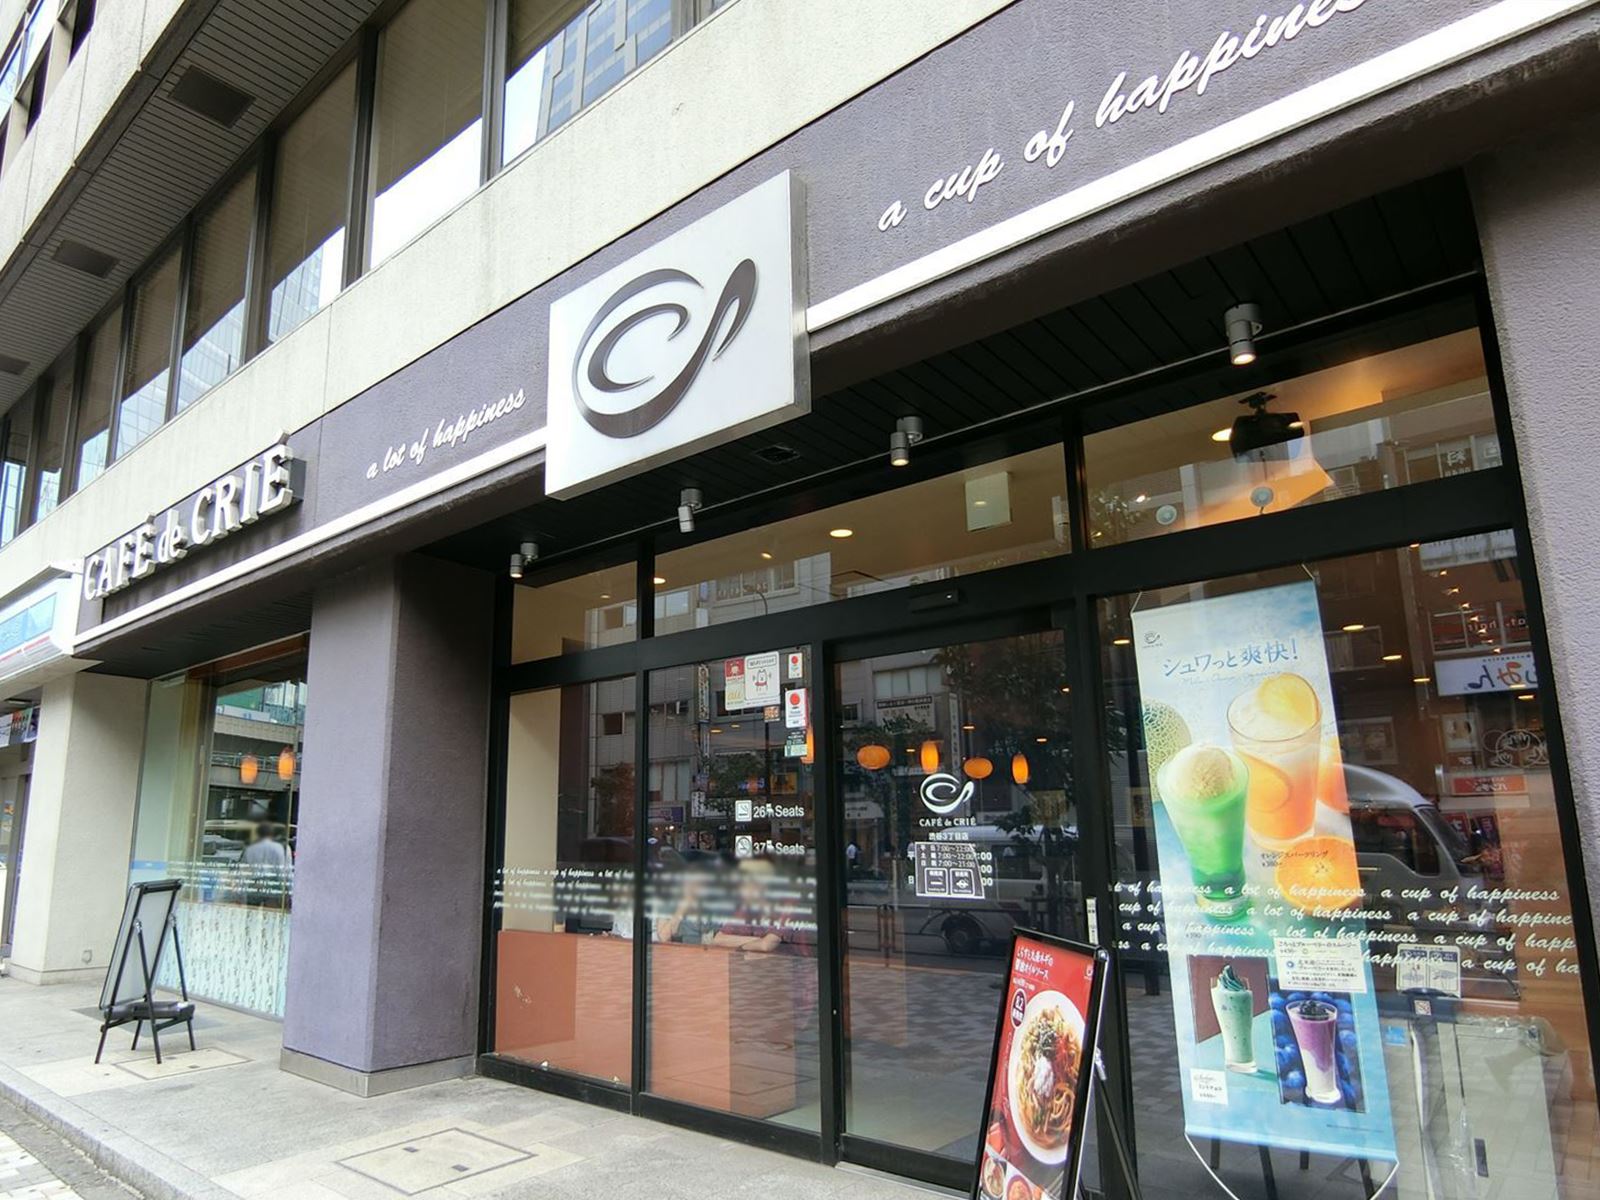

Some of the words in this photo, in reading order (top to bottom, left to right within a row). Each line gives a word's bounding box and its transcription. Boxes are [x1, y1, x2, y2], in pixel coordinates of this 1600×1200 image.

[878, 200, 908, 231] a
[923, 148, 1004, 210] cup
[1023, 100, 1074, 167] of
[366, 462, 378, 479] a
[383, 444, 406, 472] lot
[410, 428, 428, 465] of
[433, 388, 526, 448] happiness
[84, 512, 157, 600] CAFÉ
[157, 509, 187, 564] de
[191, 429, 293, 545] CRIÉ
[753, 806, 766, 818] 26
[775, 805, 804, 817] Seats
[919, 817, 942, 827] CAFÉ
[953, 816, 976, 826] CRIÉ
[753, 842, 766, 854] 37
[776, 842, 806, 855] Seats
[1128, 881, 1141, 896] of
[1224, 886, 1235, 895] a
[1267, 885, 1280, 897] of
[1289, 884, 1366, 899] happiness
[1380, 888, 1393, 898] a
[1401, 888, 1432, 903] cup
[1440, 886, 1459, 903] of
[1466, 885, 1560, 904] happiness
[1119, 902, 1141, 915] cup
[1147, 902, 1160, 916] of
[1246, 908, 1256, 916] a
[1264, 904, 1283, 917] lot
[1290, 907, 1305, 921] of
[1312, 905, 1392, 921] happiness
[1407, 910, 1420, 920] a
[1428, 910, 1460, 925] cup
[1468, 909, 1487, 926] of
[1122, 921, 1132, 930] a
[1137, 922, 1160, 935] cup
[1269, 928, 1279, 936] a
[1286, 926, 1307, 938] lot
[1314, 926, 1328, 939] of
[1337, 926, 1418, 944] happiness
[1434, 934, 1447, 944] a
[1455, 933, 1488, 949] cup
[1496, 932, 1516, 950] of
[1141, 942, 1151, 950] a
[1462, 959, 1474, 968] a
[1484, 958, 1517, 971] cup
[1526, 959, 1546, 975] of
